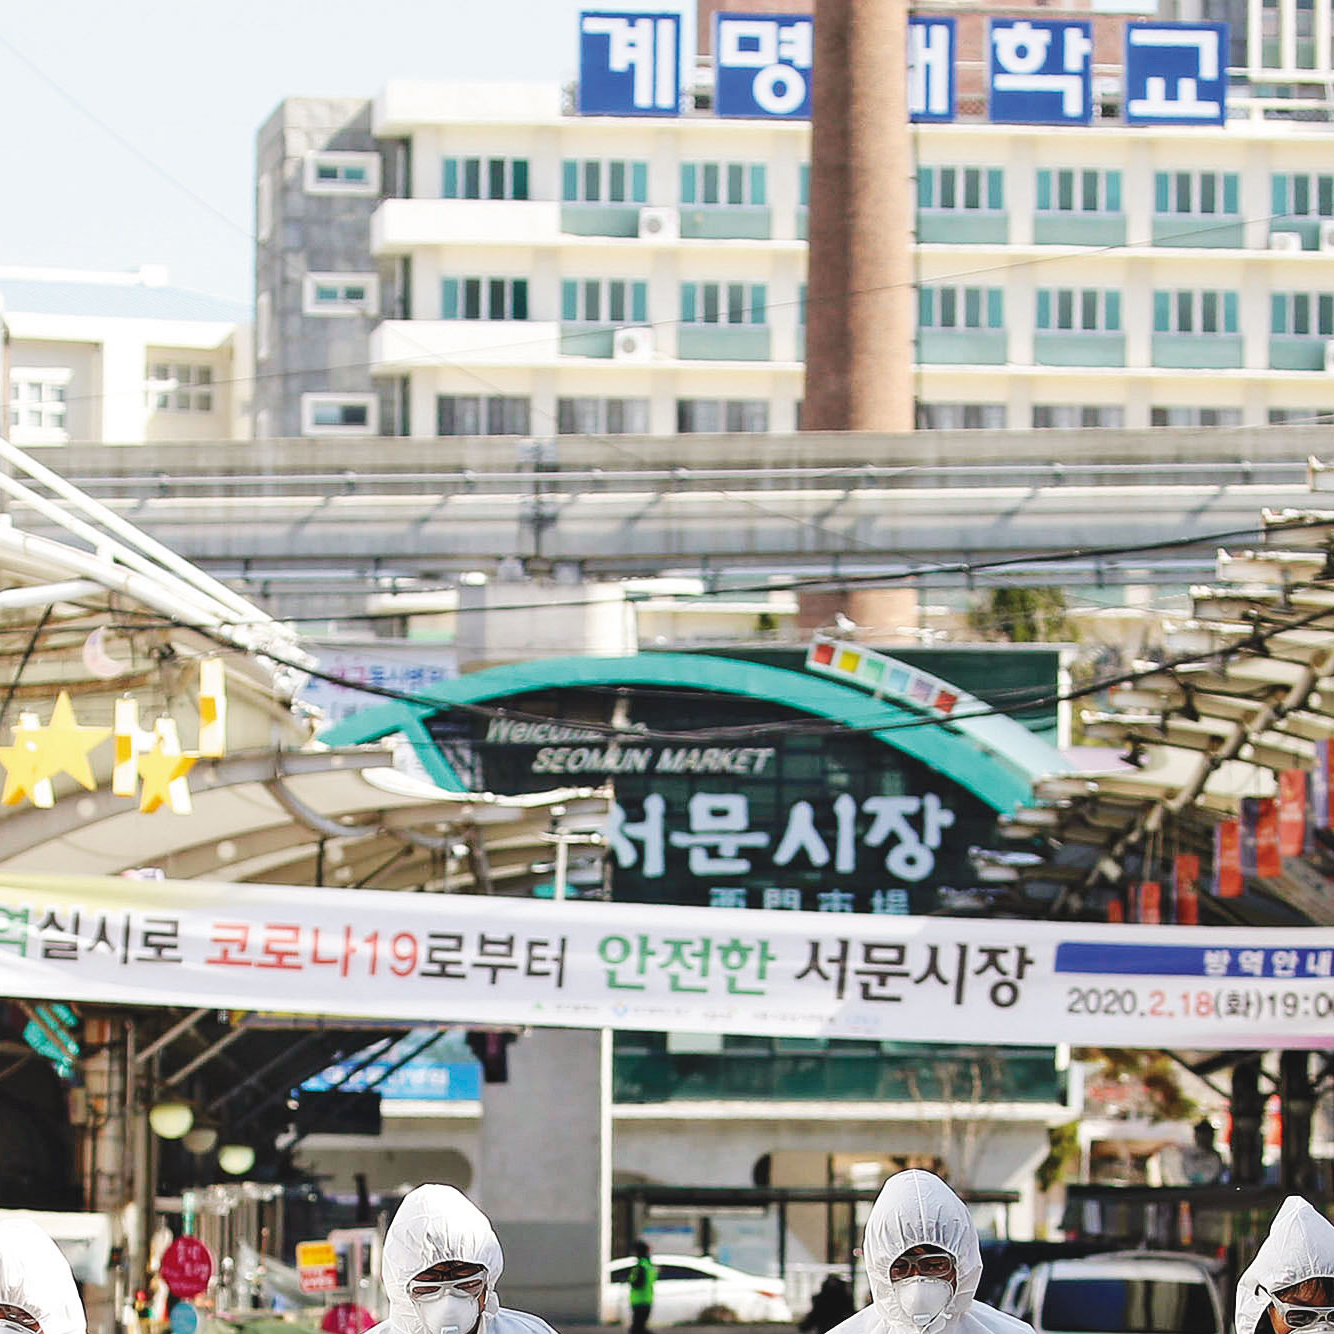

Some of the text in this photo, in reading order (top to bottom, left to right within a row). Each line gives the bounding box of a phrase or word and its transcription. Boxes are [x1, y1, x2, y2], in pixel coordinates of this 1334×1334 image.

[531, 747, 775, 775] SEOMUN MARKET
[607, 792, 956, 882] 서문시장
[205, 921, 567, 988] 코로나19로부터
[597, 933, 776, 996] 안전한
[794, 937, 1036, 1008] 서문시장
[1203, 949, 1334, 977] 방역안내
